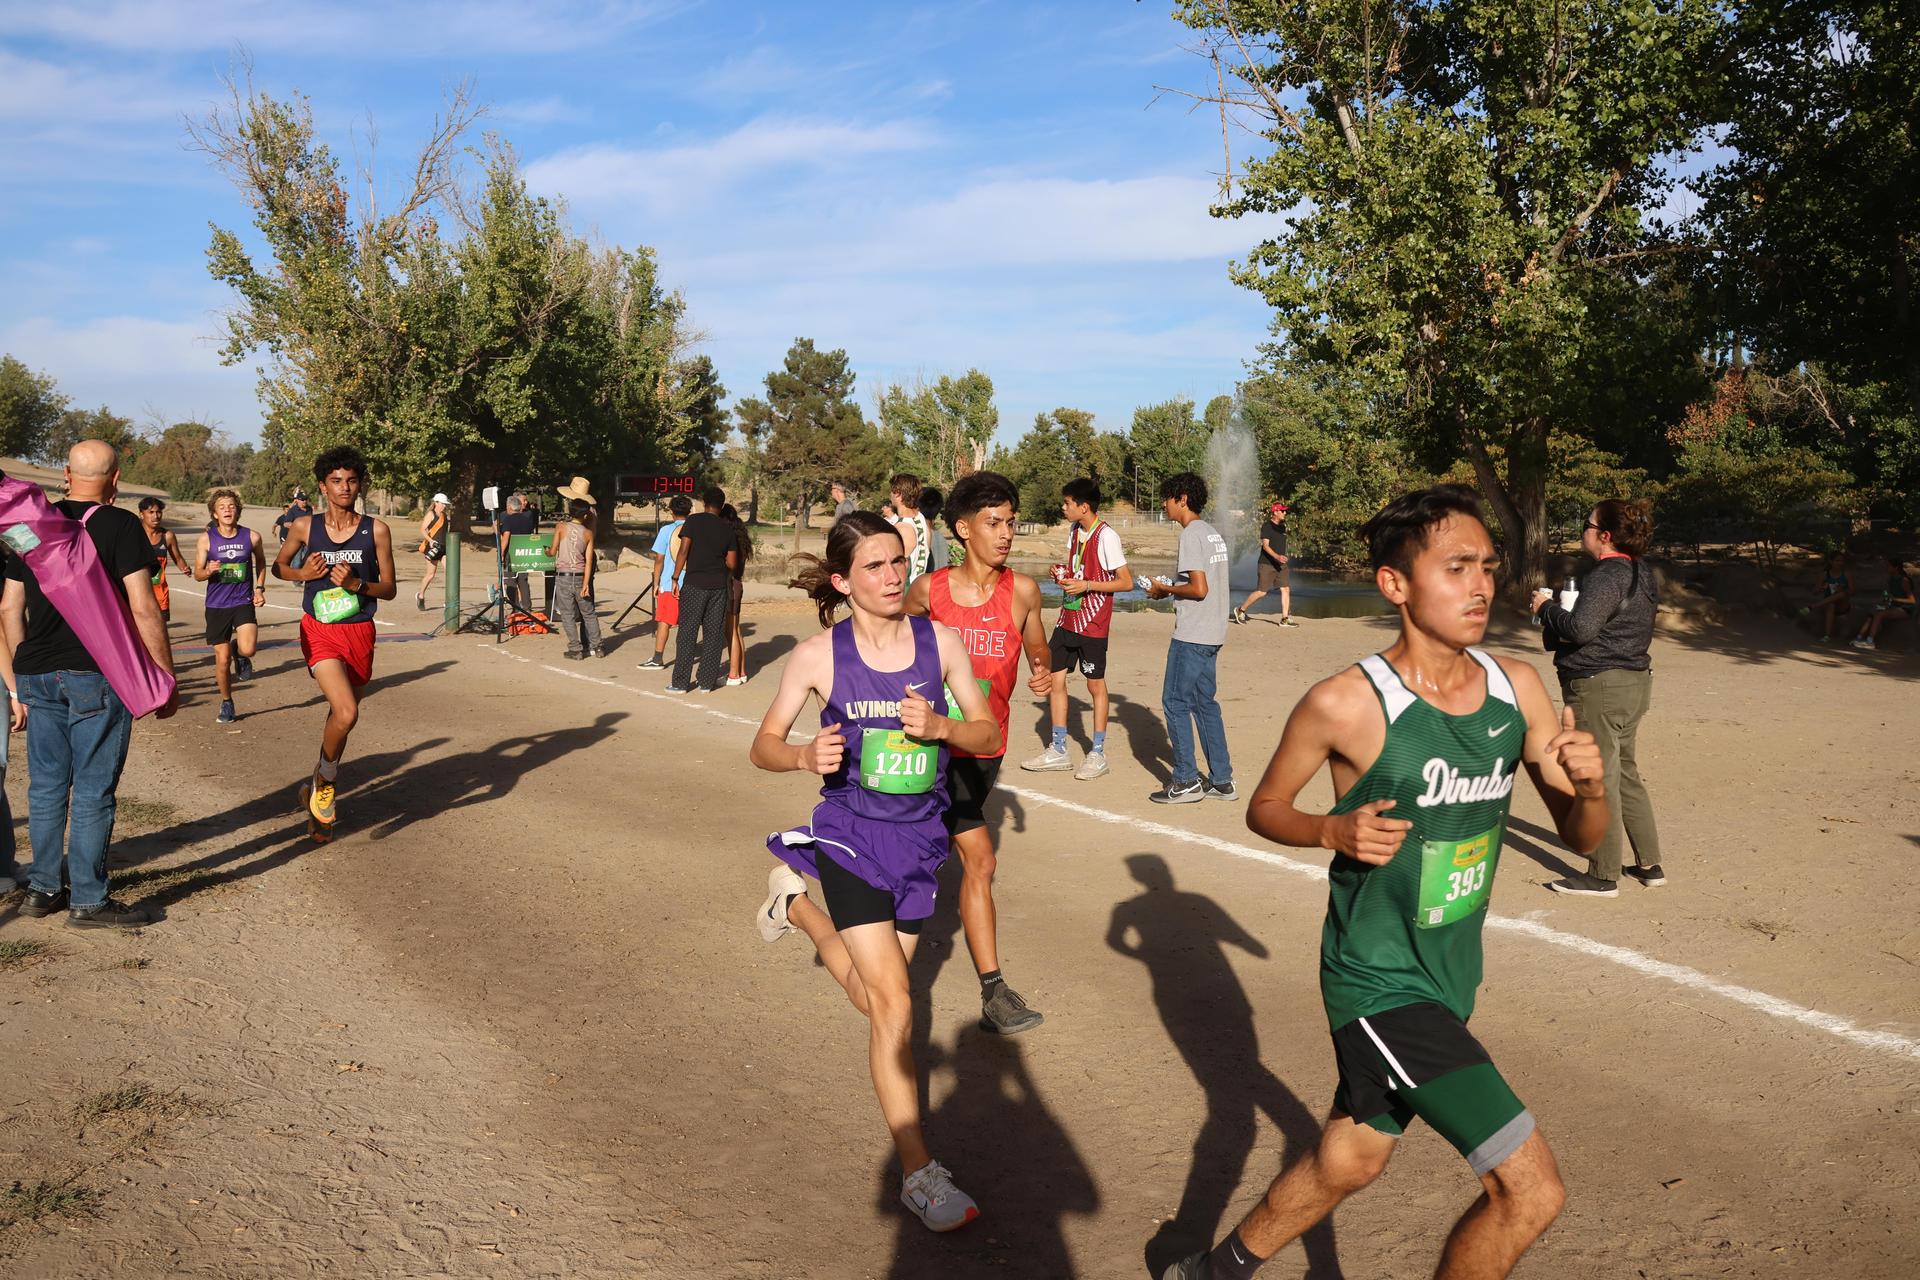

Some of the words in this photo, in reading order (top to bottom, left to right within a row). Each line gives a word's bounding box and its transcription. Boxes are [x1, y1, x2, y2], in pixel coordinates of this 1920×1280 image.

[515, 548, 543, 557] MILE
[913, 517, 926, 576] JAYHA
[320, 597, 352, 615] 1225
[947, 627, 1007, 657] IBE
[846, 700, 935, 719] LIVINGS
[875, 752, 928, 775] 1210
[1446, 861, 1486, 901] 393
